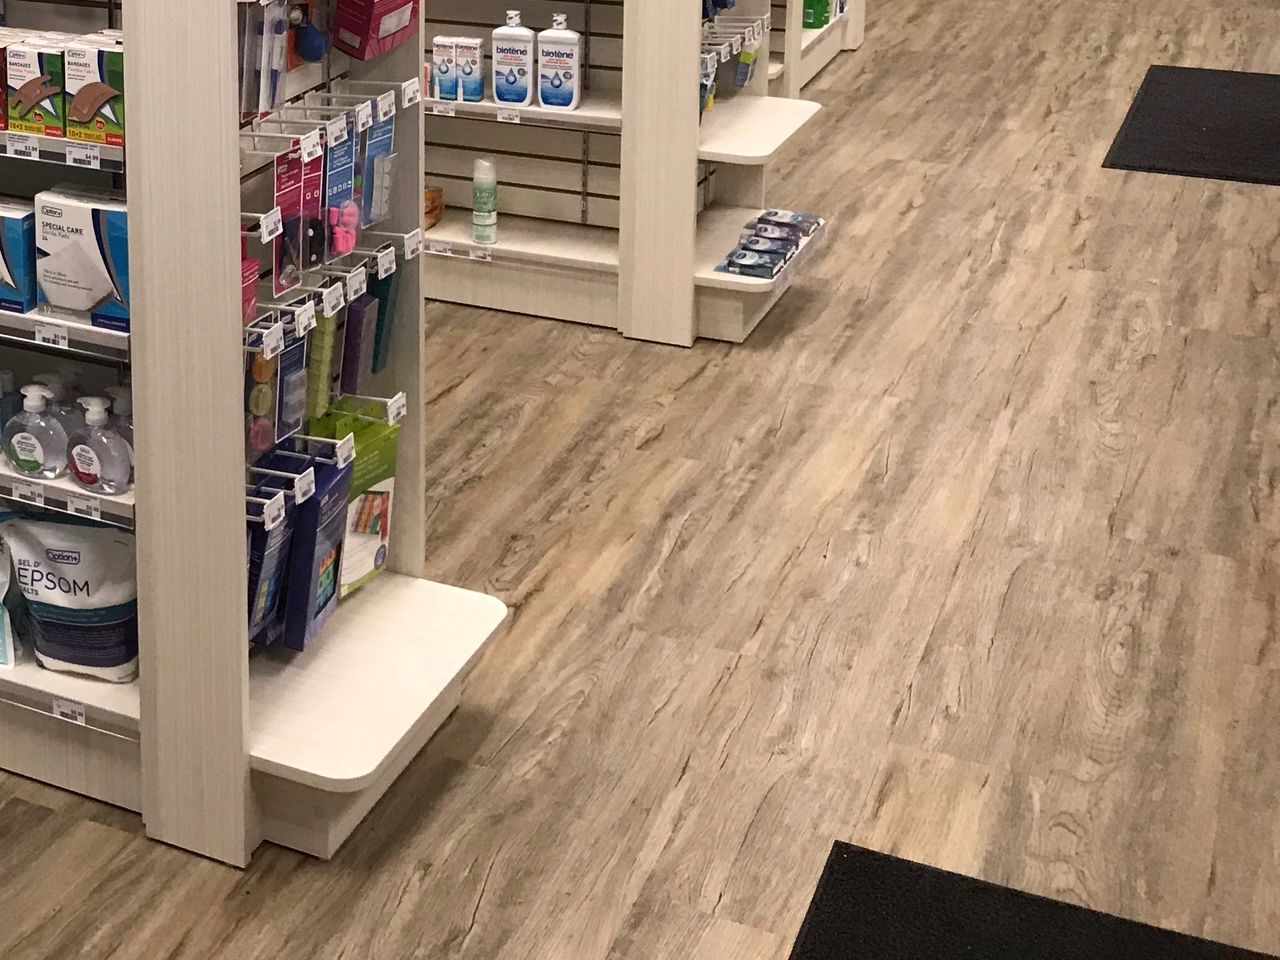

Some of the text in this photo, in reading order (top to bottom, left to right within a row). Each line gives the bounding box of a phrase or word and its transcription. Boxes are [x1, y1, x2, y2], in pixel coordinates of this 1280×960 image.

[496, 45, 527, 56] biotène
[542, 48, 574, 59] biotène
[42, 221, 83, 235] SPECIAL CARE
[44, 305, 51, 314] 12
[18, 558, 33, 567] SEL
[47, 549, 81, 565] Option+
[17, 567, 91, 597] EPSOM
